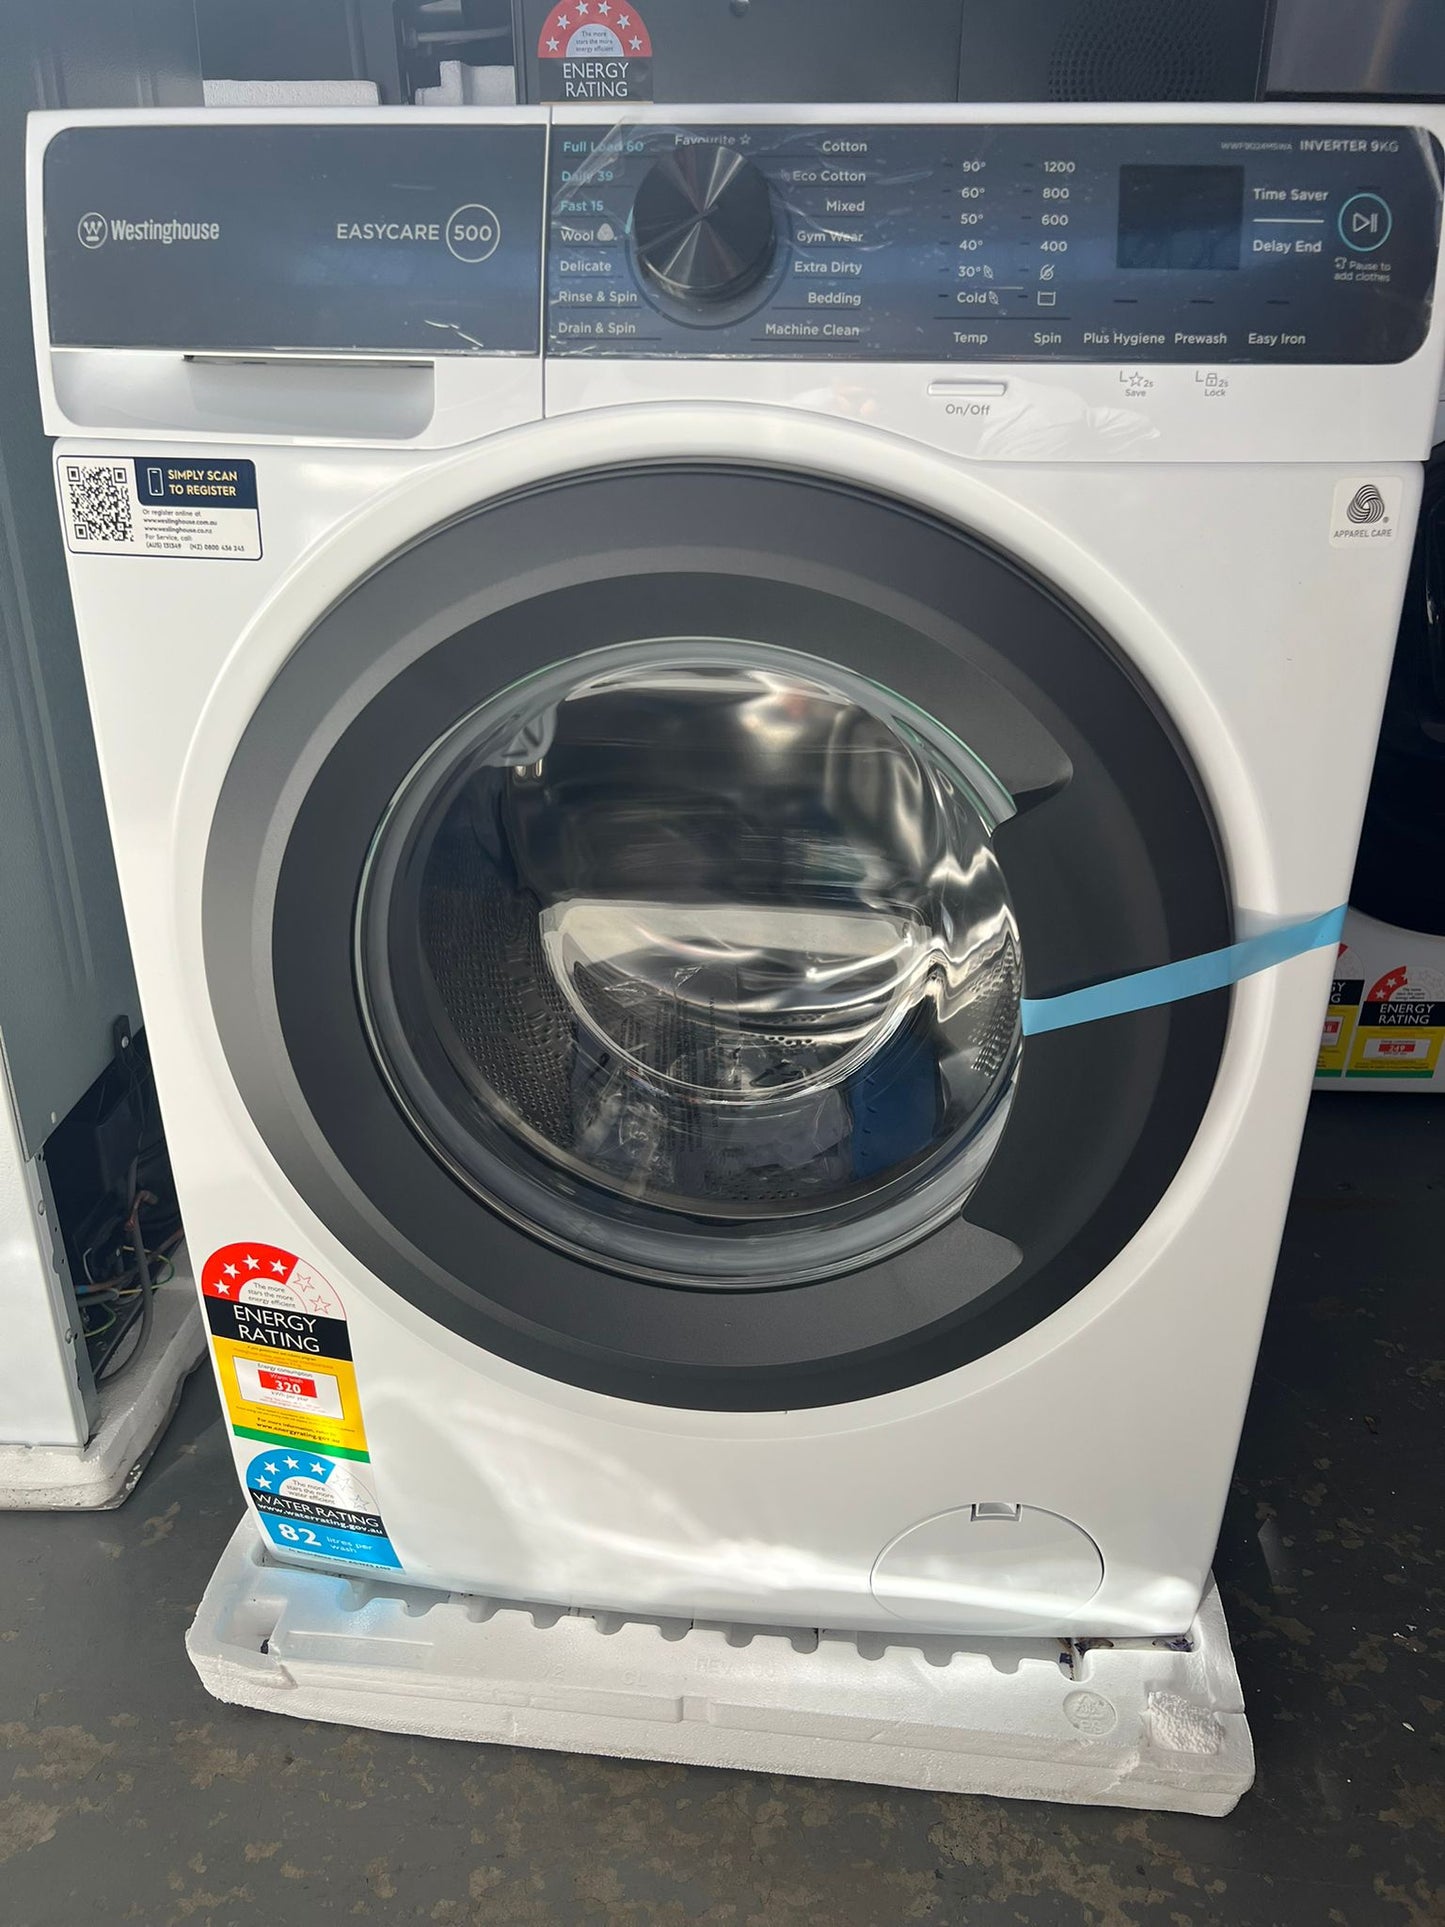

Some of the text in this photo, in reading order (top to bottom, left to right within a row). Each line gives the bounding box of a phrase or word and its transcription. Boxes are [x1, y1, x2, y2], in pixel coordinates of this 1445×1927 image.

[563, 62, 629, 79] ENERGY
[566, 81, 628, 97] RATING
[563, 141, 587, 152] Full
[626, 141, 644, 152] 60
[674, 135, 735, 146] Favourite
[822, 141, 868, 152] Cotton
[1300, 140, 1368, 152] INVERTER
[1370, 141, 1400, 153] 9KG
[1044, 161, 1076, 173] 1200
[596, 171, 614, 181] 39
[792, 170, 866, 182] Eco Cotton
[1042, 187, 1070, 199] 800
[1253, 188, 1329, 202] Time Saver
[560, 201, 604, 212] Fast 15
[826, 200, 865, 212] Mixed
[1041, 214, 1069, 226] 600
[110, 219, 220, 244] Westinghouse
[336, 223, 492, 241] EASYCARE 500
[561, 230, 594, 241] Wool
[797, 229, 864, 243] Gym Wear
[1040, 241, 1068, 252] 400
[1253, 239, 1322, 254] Delay End
[560, 260, 612, 272] Delicate
[794, 261, 862, 275] Extra Dirty
[1349, 261, 1391, 272] Pause to
[1334, 271, 1391, 282] add clothes
[559, 291, 638, 304] Rinse & Spin
[808, 292, 861, 306] Bedding
[957, 291, 987, 304] Cold
[558, 322, 636, 335] Drain & Spin
[765, 324, 860, 336] Machine Clean
[953, 332, 989, 345] Temp
[1033, 332, 1062, 346] Spin
[1083, 332, 1166, 347] Plus Hygiene
[1174, 332, 1228, 345] Prewash
[1248, 332, 1306, 347] Easy Iron
[1125, 388, 1146, 397] Save
[1204, 388, 1226, 397] Lock
[945, 403, 991, 415] On/Off
[168, 470, 238, 482] SIMPLY SCAN
[169, 484, 237, 496] TO REGISTER
[1333, 529, 1392, 538] APPAREL CARE
[1380, 1003, 1435, 1014] ENERGY
[1379, 1014, 1430, 1025] RATING
[254, 1281, 286, 1293] The more
[248, 1288, 294, 1301] stars the more
[248, 1295, 269, 1304] energy
[233, 1304, 317, 1333] ENERGY
[238, 1324, 320, 1353] RATING
[257, 1362, 276, 1372] Energy
[275, 1379, 302, 1394] 320
[293, 1479, 326, 1492] The more
[315, 1491, 334, 1500] more
[253, 1492, 379, 1527] WATER RATING
[257, 1503, 383, 1535] www.waterrating.gov.au
[278, 1523, 322, 1546] 82
[330, 1544, 357, 1554] wash
[354, 1543, 373, 1551] per
